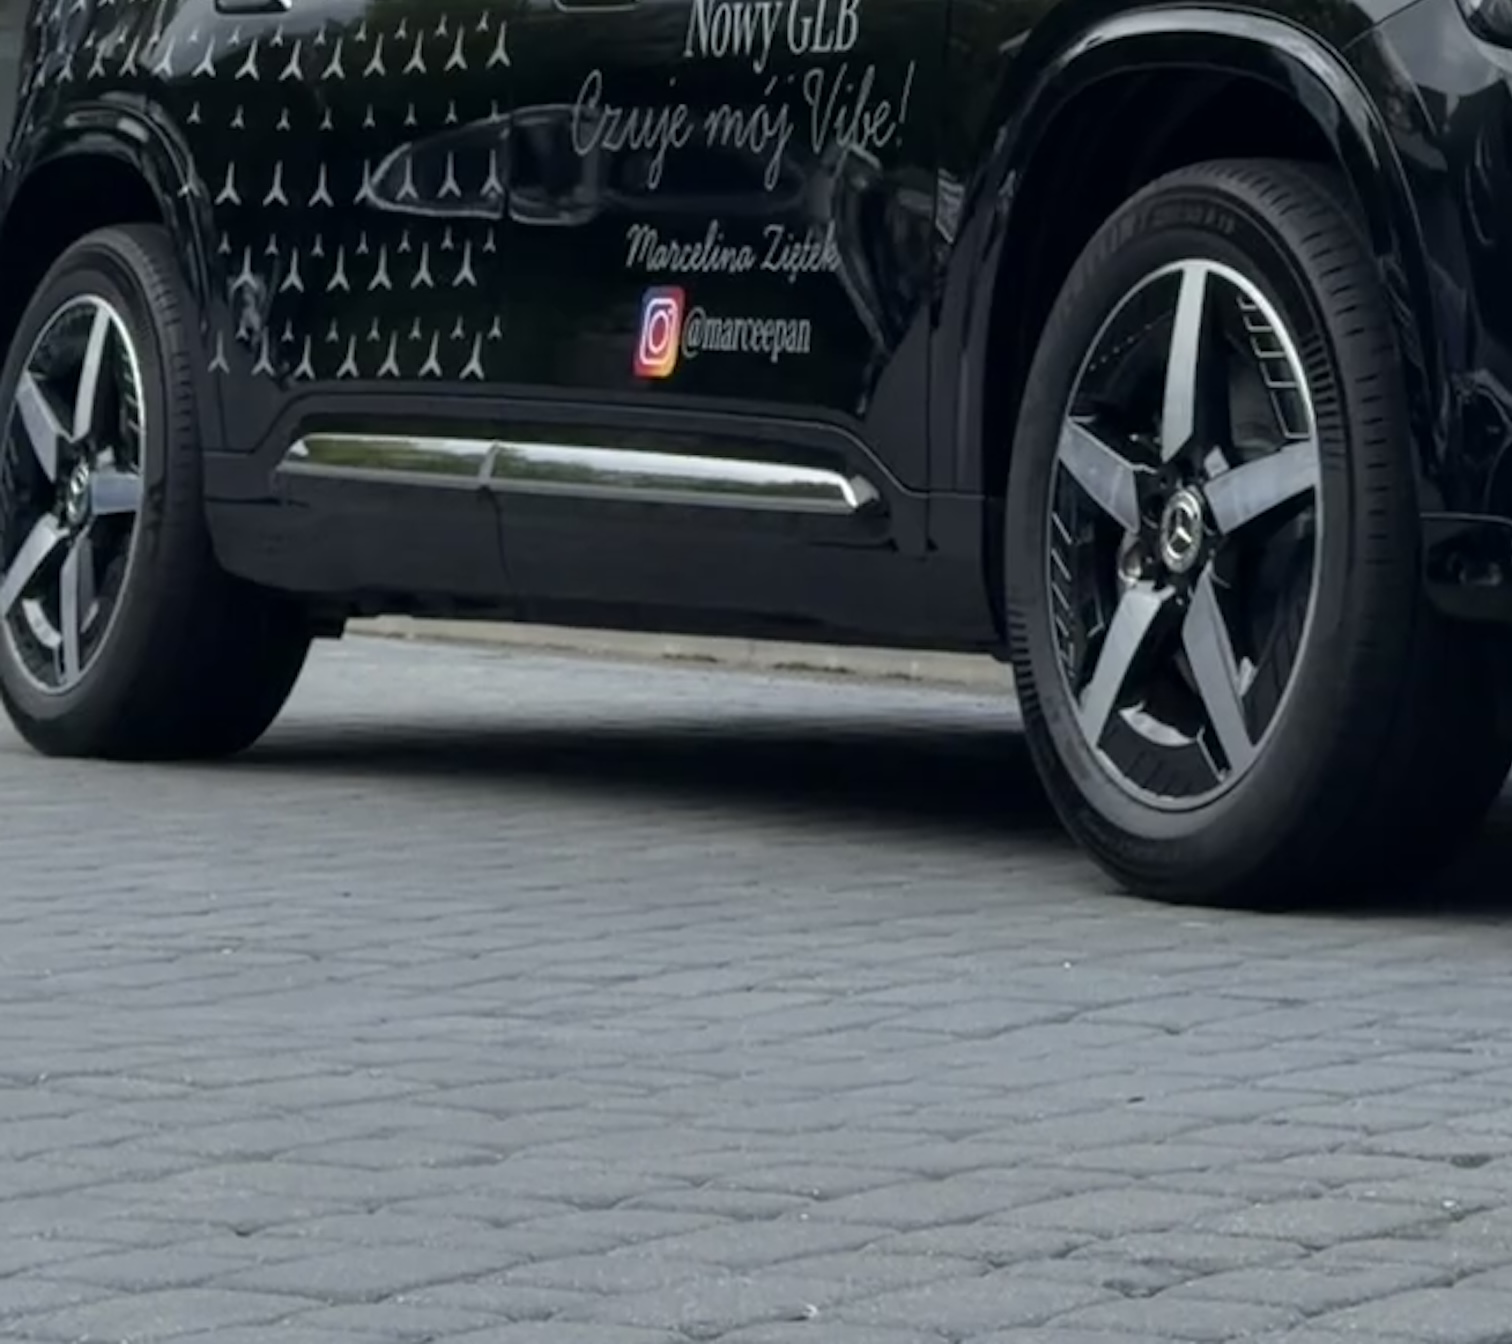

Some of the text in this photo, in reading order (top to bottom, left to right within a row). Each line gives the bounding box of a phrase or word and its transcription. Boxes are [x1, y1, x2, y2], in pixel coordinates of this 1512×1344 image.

[571, 69, 695, 190] Czuje
[704, 74, 796, 191] mój
[626, 219, 755, 274] Marcelina
[682, 306, 811, 363] @marceepan
